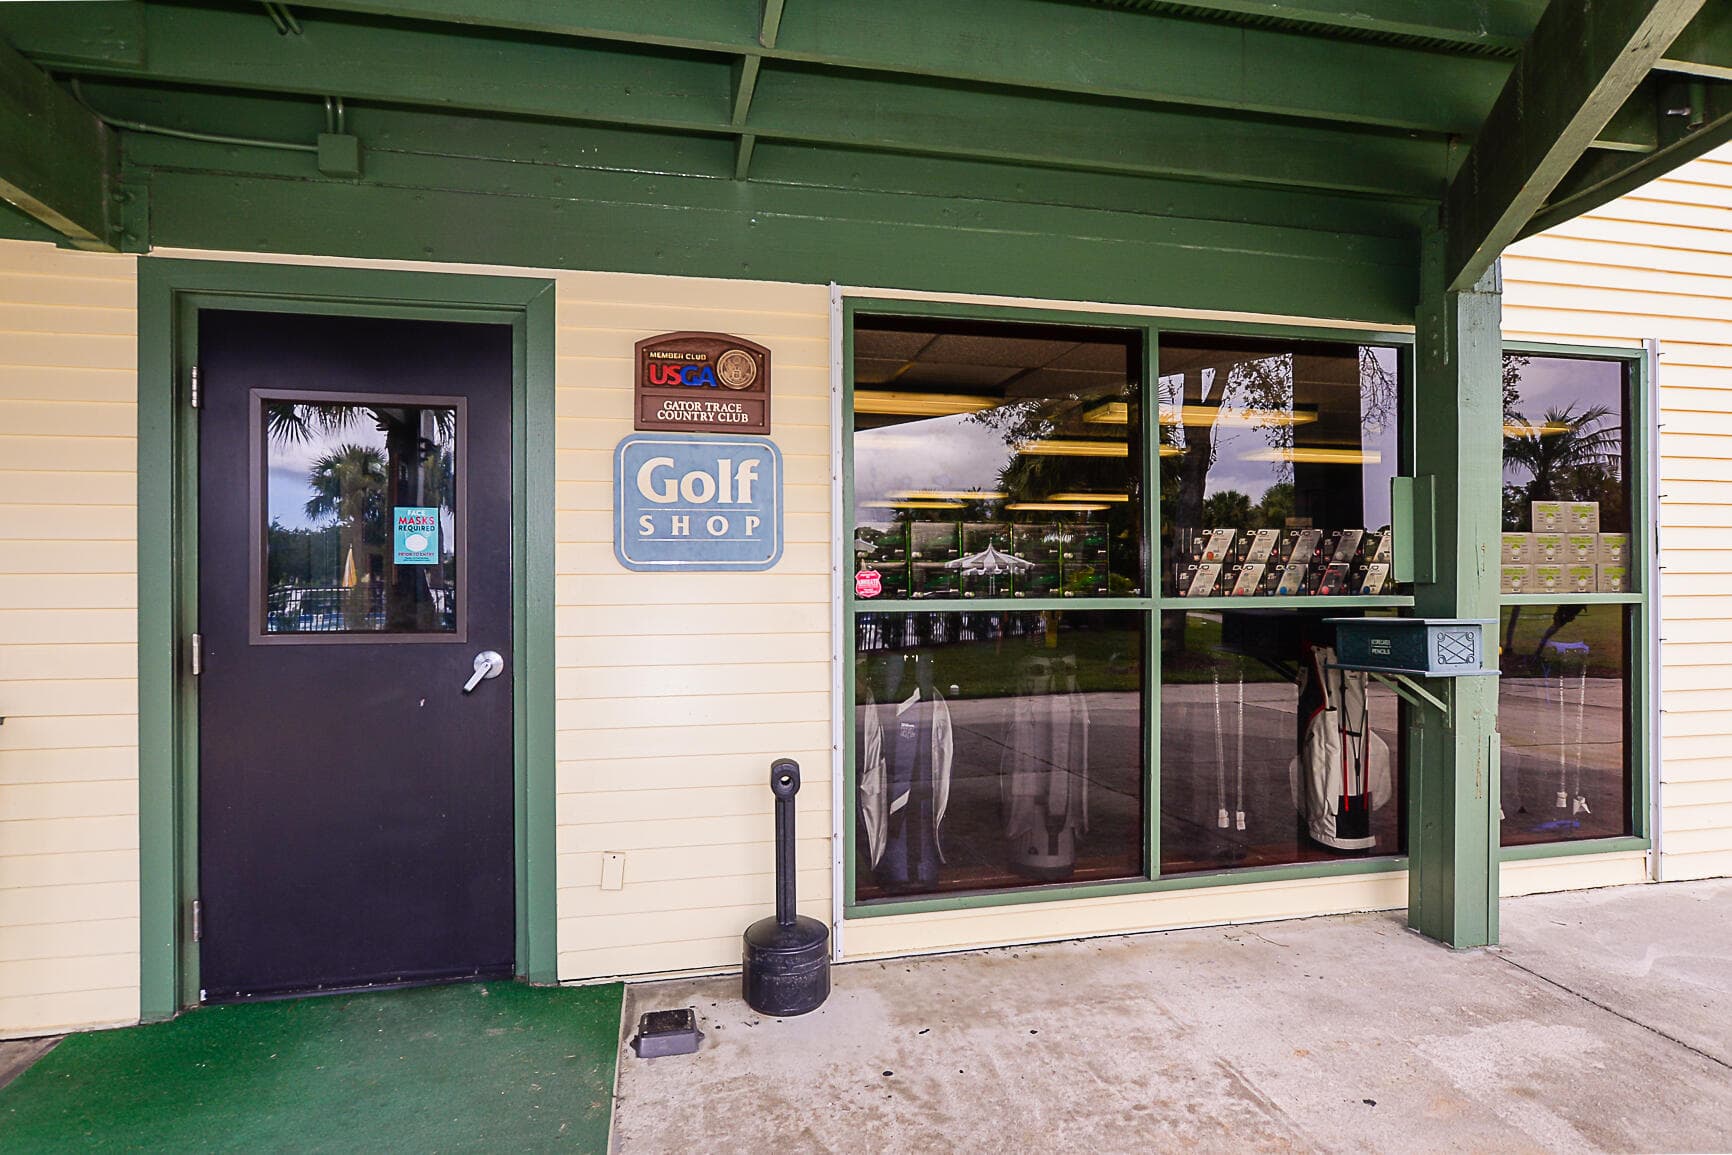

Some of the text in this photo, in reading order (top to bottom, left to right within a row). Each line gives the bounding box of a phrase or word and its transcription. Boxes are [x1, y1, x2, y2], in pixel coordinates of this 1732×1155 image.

[650, 351, 707, 361] MEMBER CLUB
[649, 364, 718, 387] USGA
[664, 400, 743, 413] GATOR TRACE
[657, 410, 749, 423] COUNTRY CLUB
[636, 456, 761, 505] Golf
[399, 516, 435, 525] MASKS
[638, 514, 761, 537] SHOP
